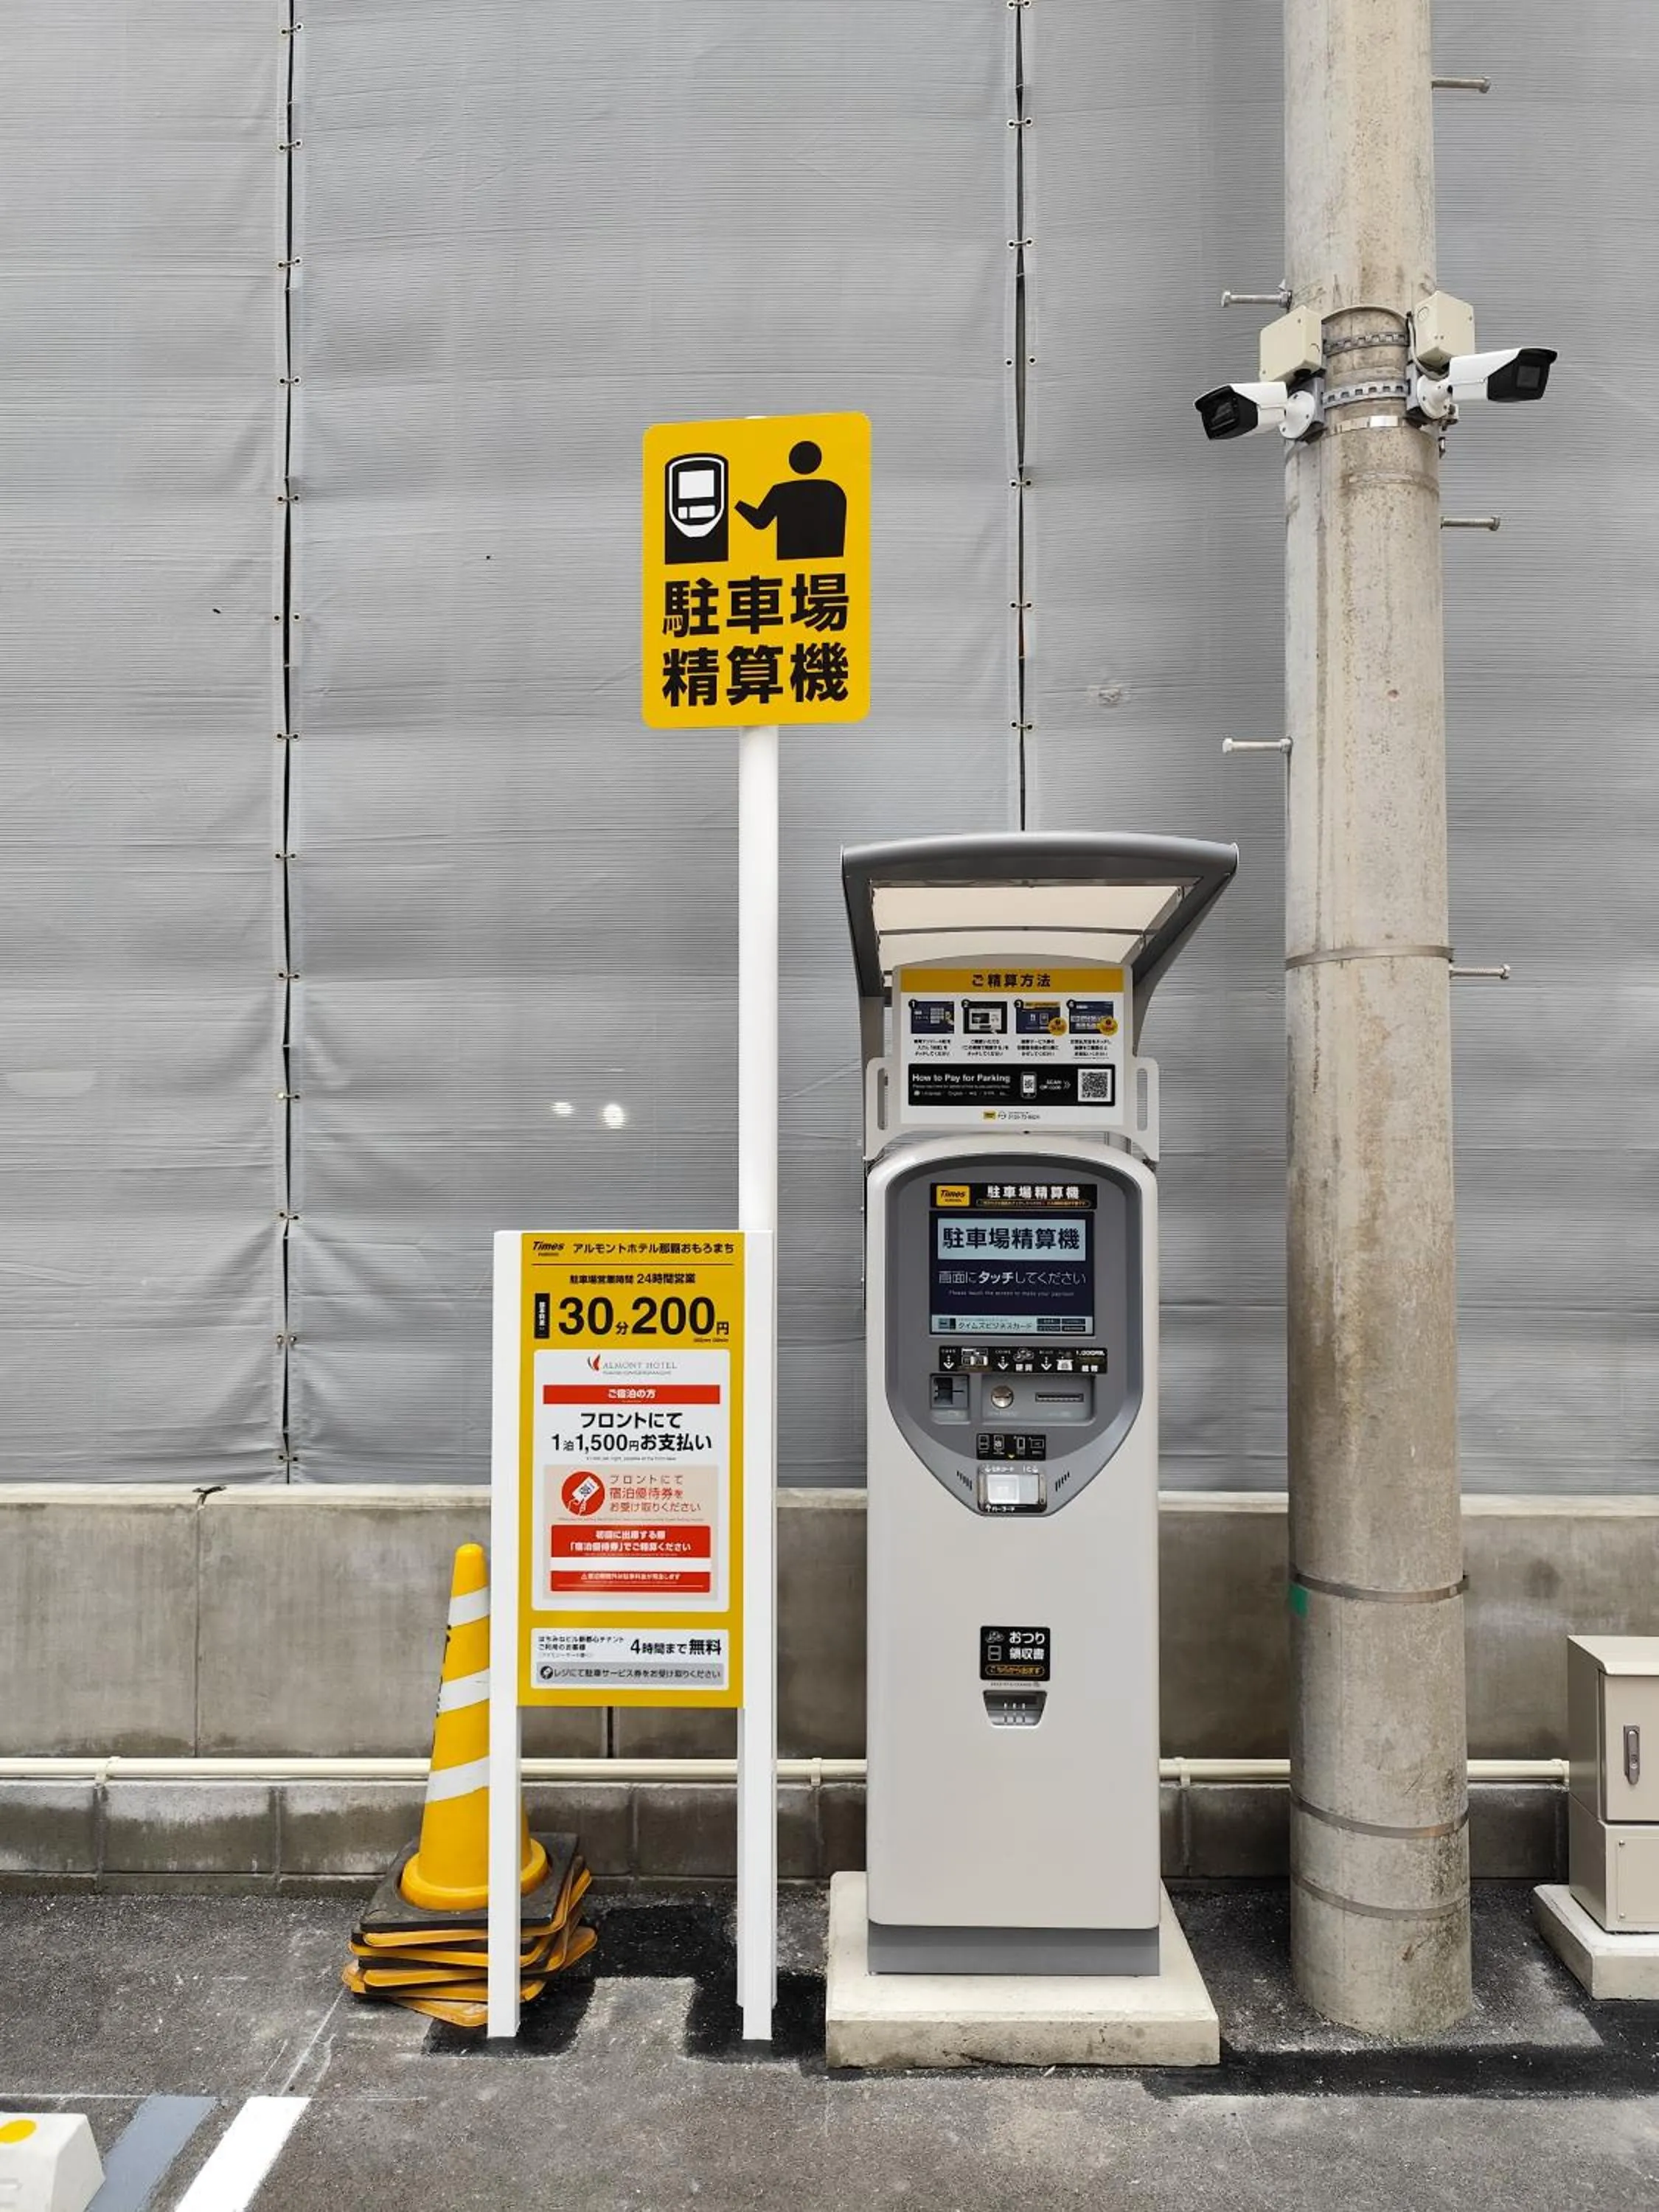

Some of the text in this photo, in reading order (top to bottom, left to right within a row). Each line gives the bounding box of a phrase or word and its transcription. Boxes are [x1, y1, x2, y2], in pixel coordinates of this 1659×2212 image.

[661, 573, 849, 638] 駐車場
[661, 641, 849, 707] 精算機
[972, 973, 1051, 987] ご精算方法
[912, 1074, 1011, 1083] How to Pay for Parking
[941, 1189, 965, 1198] Times
[987, 1185, 1080, 1199] 駐車場精算機
[942, 1228, 1079, 1250] 駐車場精算機
[533, 1241, 565, 1251] Times
[573, 1242, 734, 1254] アルモントホテル那覇おもろまち
[569, 1273, 696, 1284] 駐車場営業時間 24時間営業
[938, 1270, 1086, 1285] 画面にタッチしてください
[558, 1296, 729, 1335] 30分200円
[603, 1361, 678, 1369] ALMONT HOTEL
[608, 1388, 655, 1399] ご宿泊の方
[580, 1412, 684, 1429] フロントにて
[552, 1433, 712, 1453] 1泊1,500円お支払い
[610, 1474, 684, 1485] フロントにて
[610, 1487, 684, 1500] 宿泊優待券を
[609, 1502, 701, 1513] お受け取りください
[1009, 1631, 1045, 1644] おつり
[630, 1639, 722, 1655] 4時間まで無料
[1009, 1647, 1045, 1660] 領収書
[554, 1669, 721, 1679] レジにて駐車サービス券をお受け取りください
